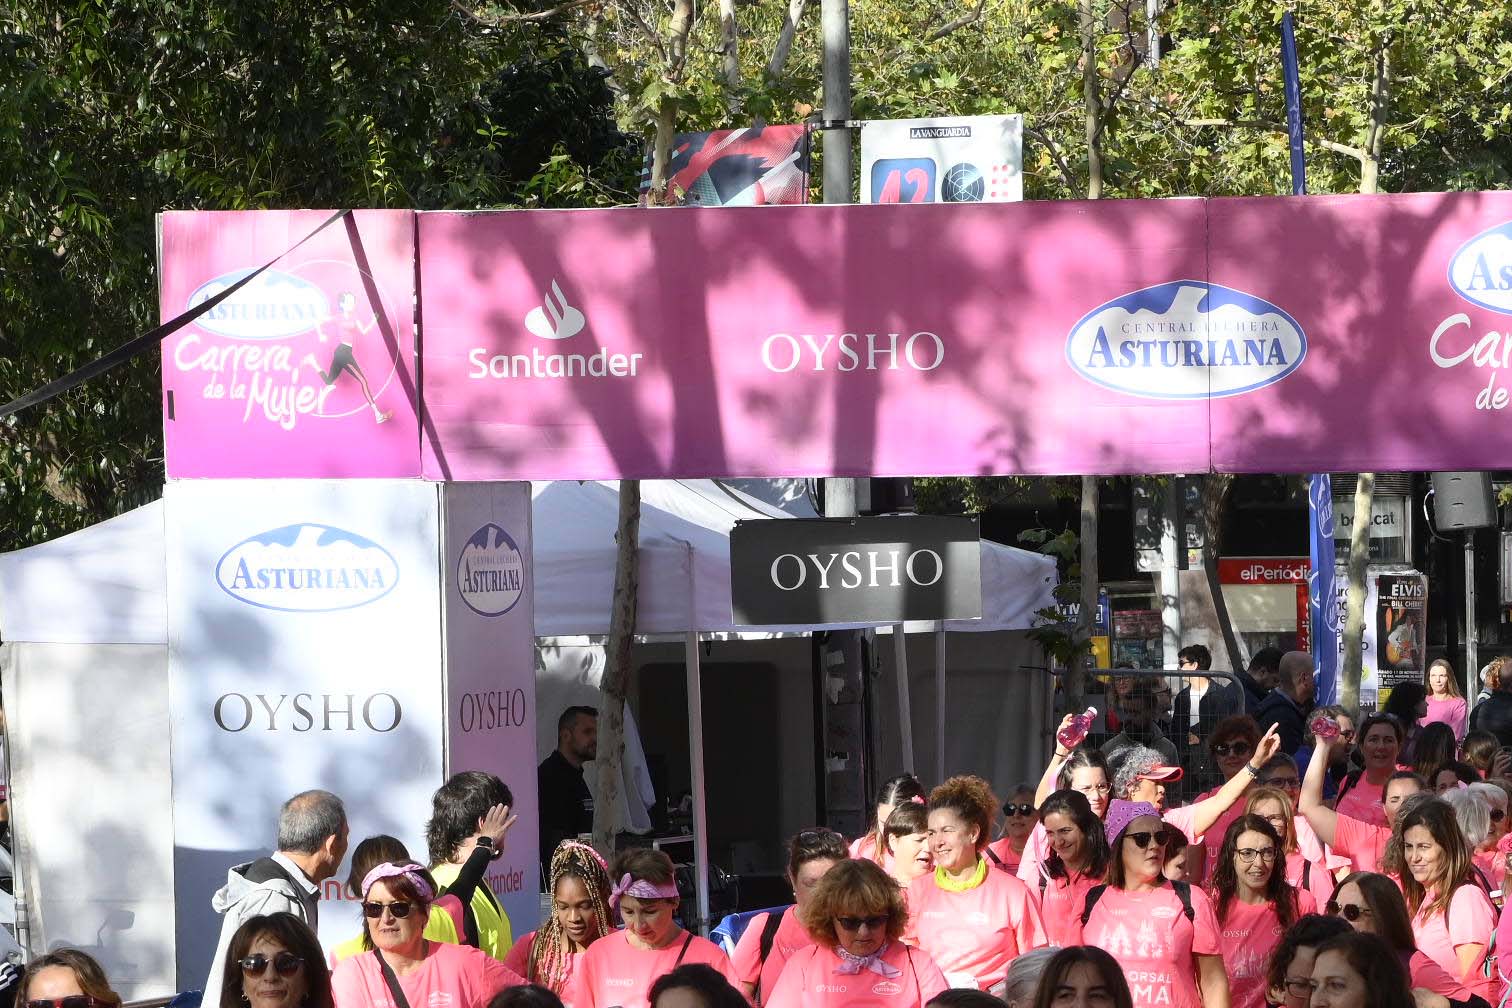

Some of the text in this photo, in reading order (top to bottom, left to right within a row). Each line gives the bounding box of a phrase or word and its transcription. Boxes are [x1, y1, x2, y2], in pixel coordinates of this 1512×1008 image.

[911, 127, 970, 138] LA VANGUARDIA
[201, 293, 318, 321] ASTURIANA
[1121, 321, 1195, 335] CENTRAL
[175, 334, 292, 372] Carrera
[468, 347, 643, 378] Santander
[760, 331, 945, 373] OYSHO
[1088, 325, 1289, 368] ASTURIANA
[203, 368, 336, 430] de la Mujer
[1475, 370, 1510, 410] de
[230, 556, 385, 590] ASTURIANA
[462, 562, 521, 593] ASTURIANA
[770, 549, 944, 592] OYSHO
[1391, 584, 1422, 597] ELVIS
[213, 692, 403, 732] OYSHO
[460, 688, 526, 733] OYSHO
[1128, 971, 1172, 984] ORSAL
